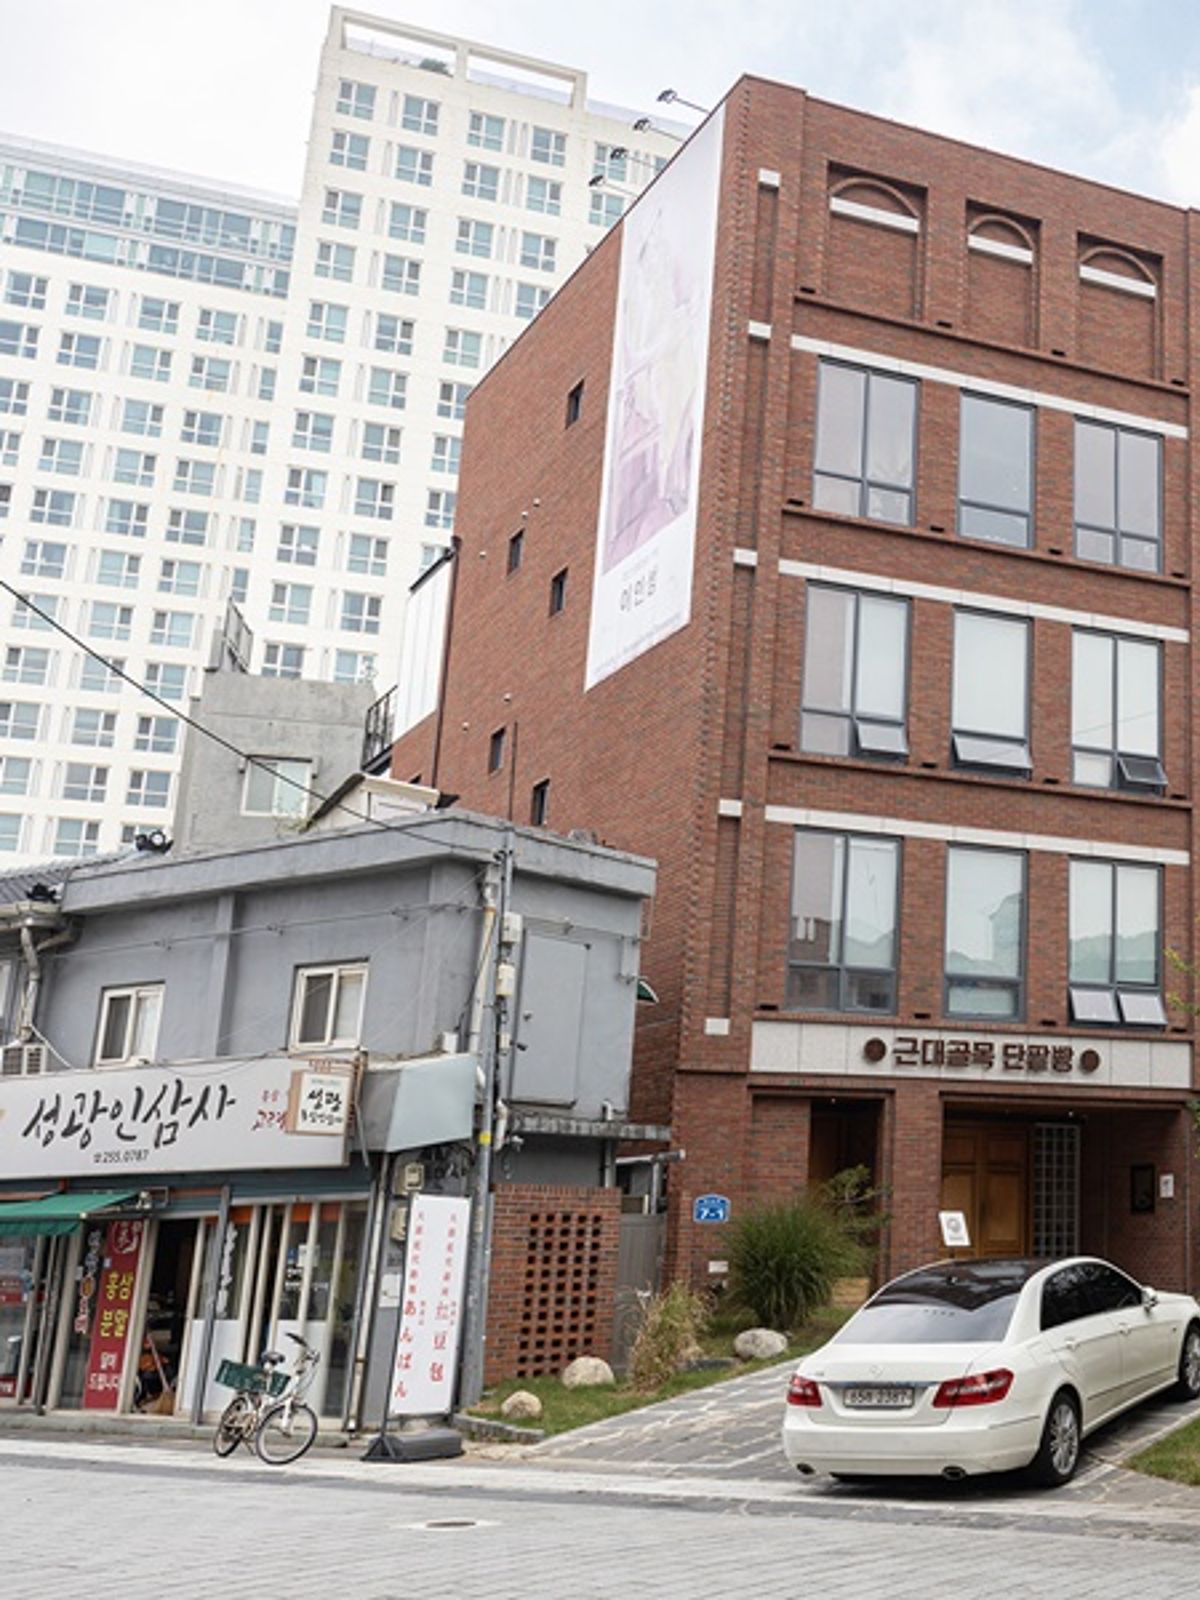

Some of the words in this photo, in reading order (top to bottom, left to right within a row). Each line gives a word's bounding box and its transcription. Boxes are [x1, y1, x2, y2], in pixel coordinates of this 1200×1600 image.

[893, 1037, 995, 1071] 근대골목
[1002, 1043, 1074, 1073] 단팥빵
[22, 1078, 236, 1150] 성광인삼사
[700, 1208, 724, 1220] 7-1
